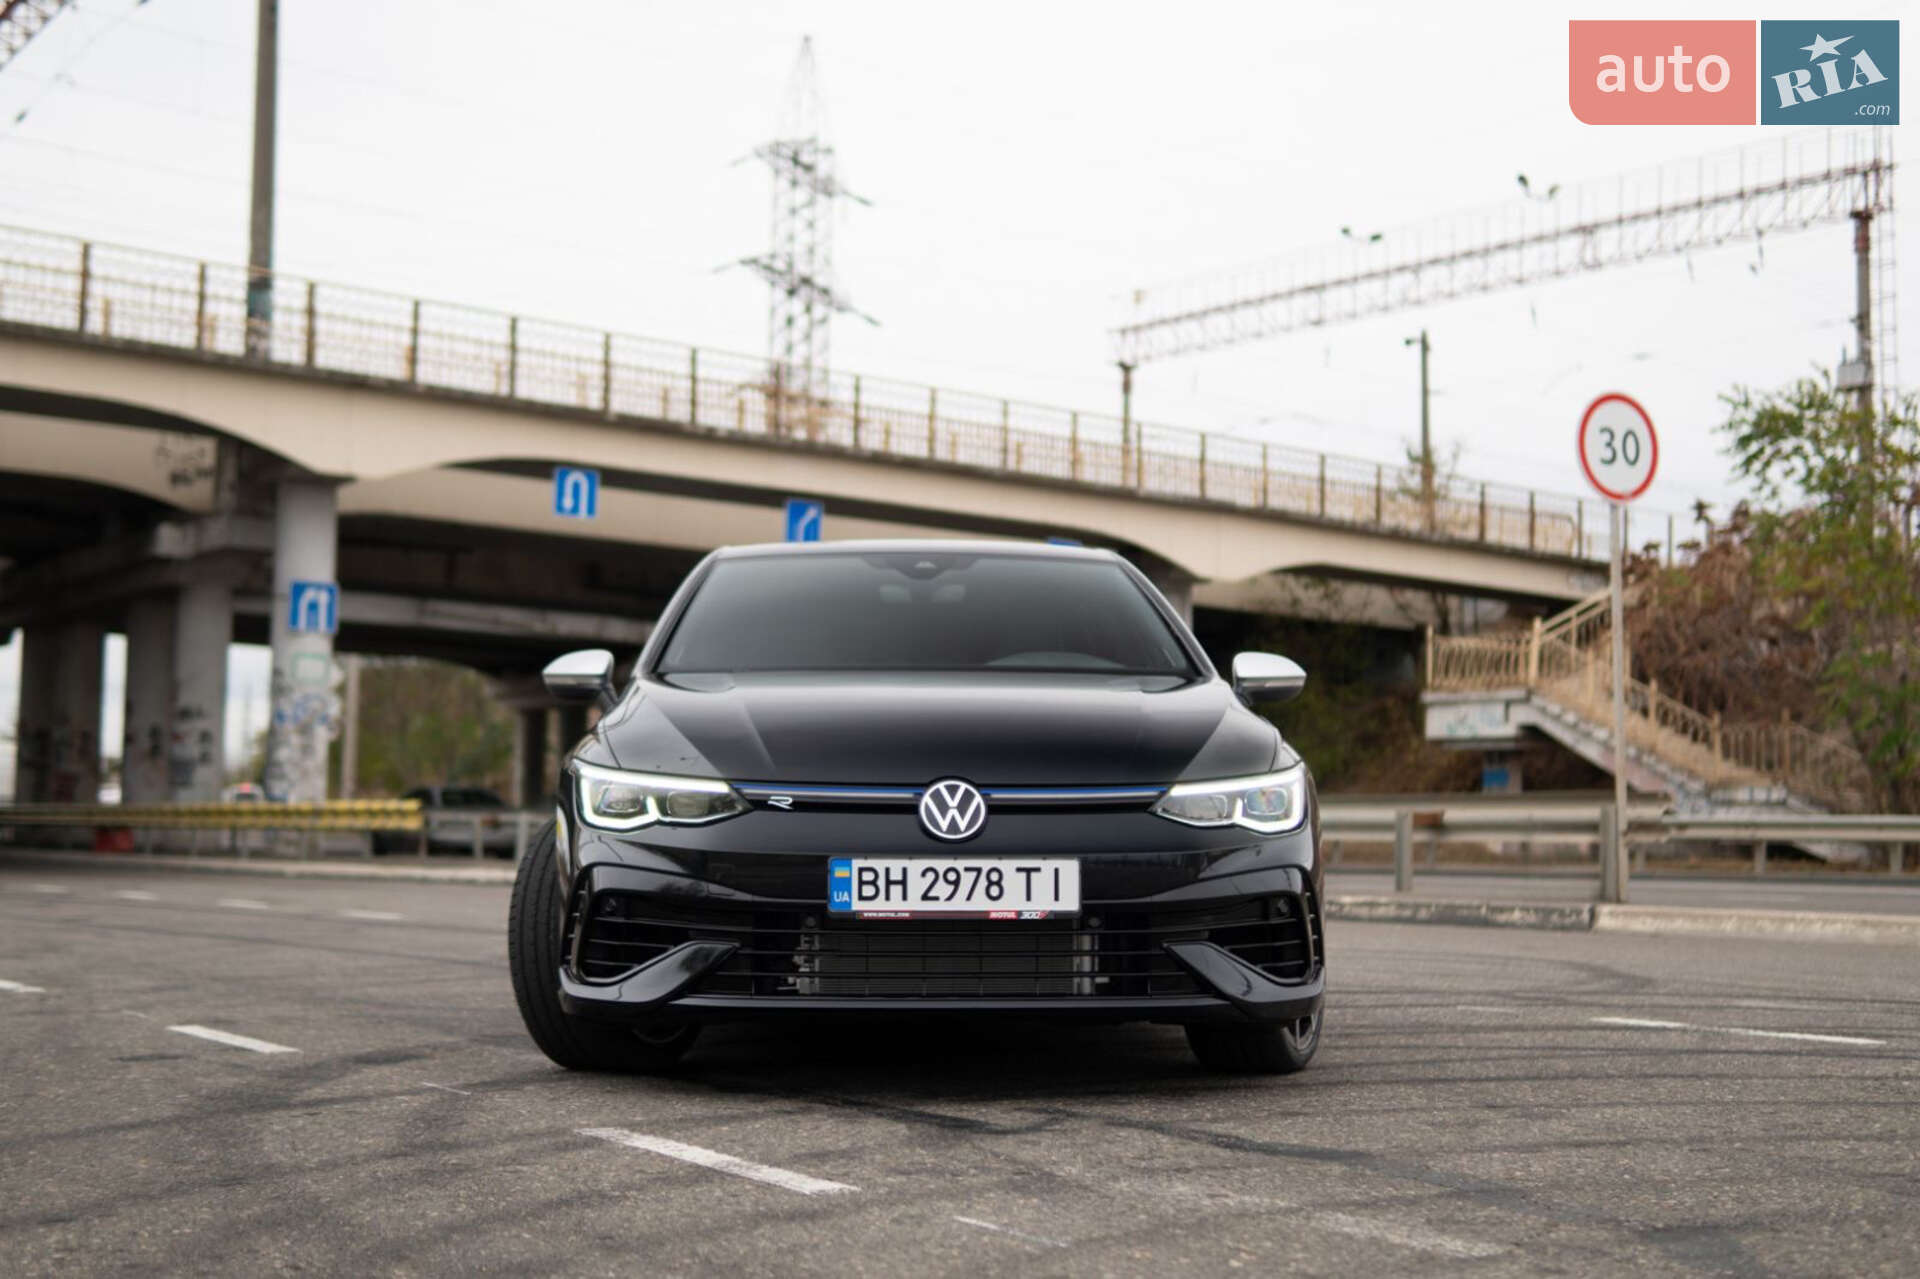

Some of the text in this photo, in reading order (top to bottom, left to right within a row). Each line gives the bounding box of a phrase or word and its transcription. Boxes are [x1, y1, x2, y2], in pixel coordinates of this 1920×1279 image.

[1599, 427, 1640, 466] 30
[834, 891, 850, 902] UA
[857, 866, 908, 901] BH
[921, 866, 1004, 901] 2978
